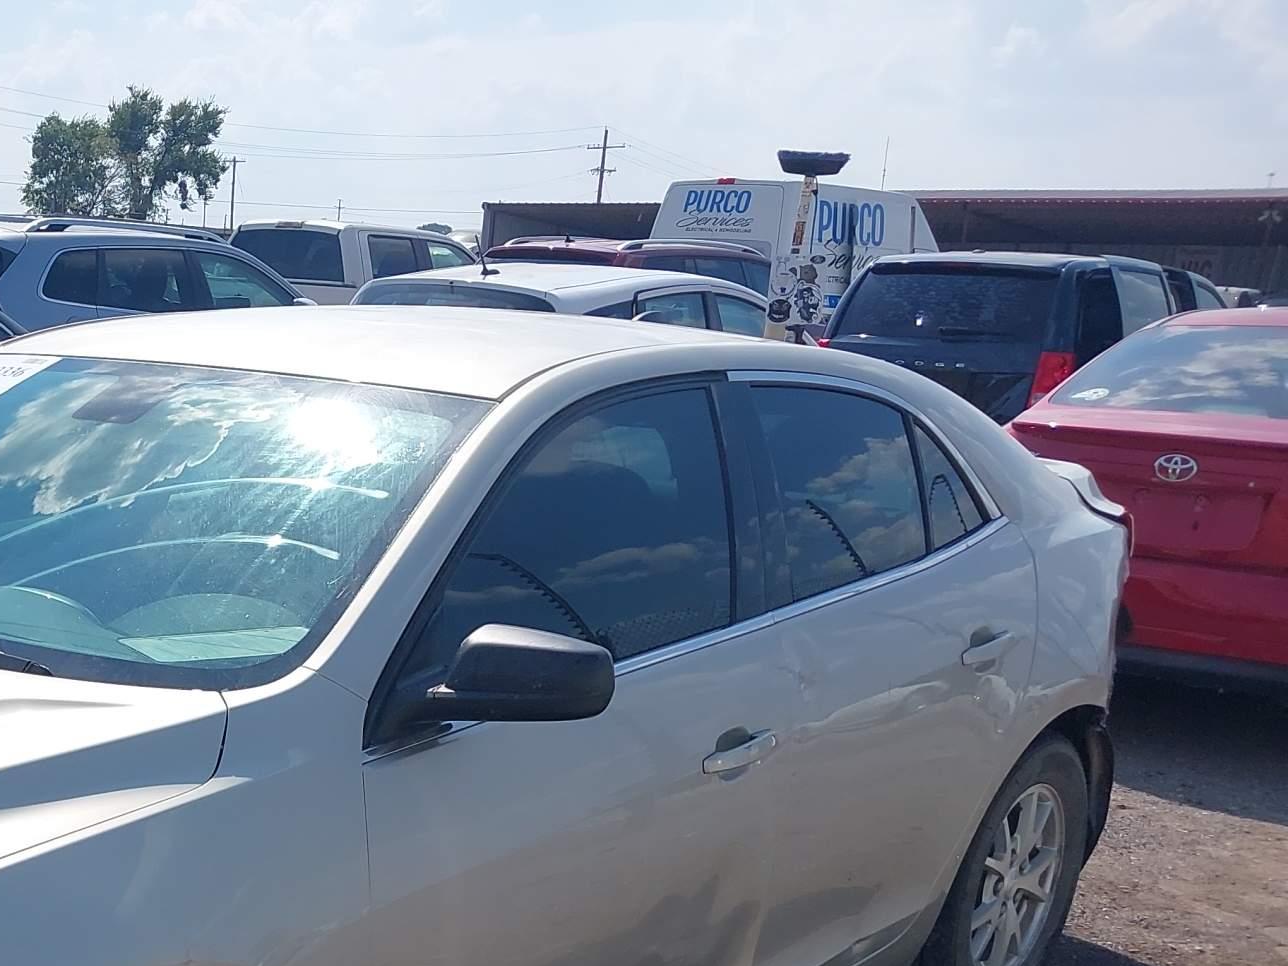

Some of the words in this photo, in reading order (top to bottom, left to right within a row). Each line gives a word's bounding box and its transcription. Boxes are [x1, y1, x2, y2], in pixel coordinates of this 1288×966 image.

[683, 189, 752, 214] PURCO
[676, 208, 754, 228] Services
[817, 199, 885, 247] PURCO
